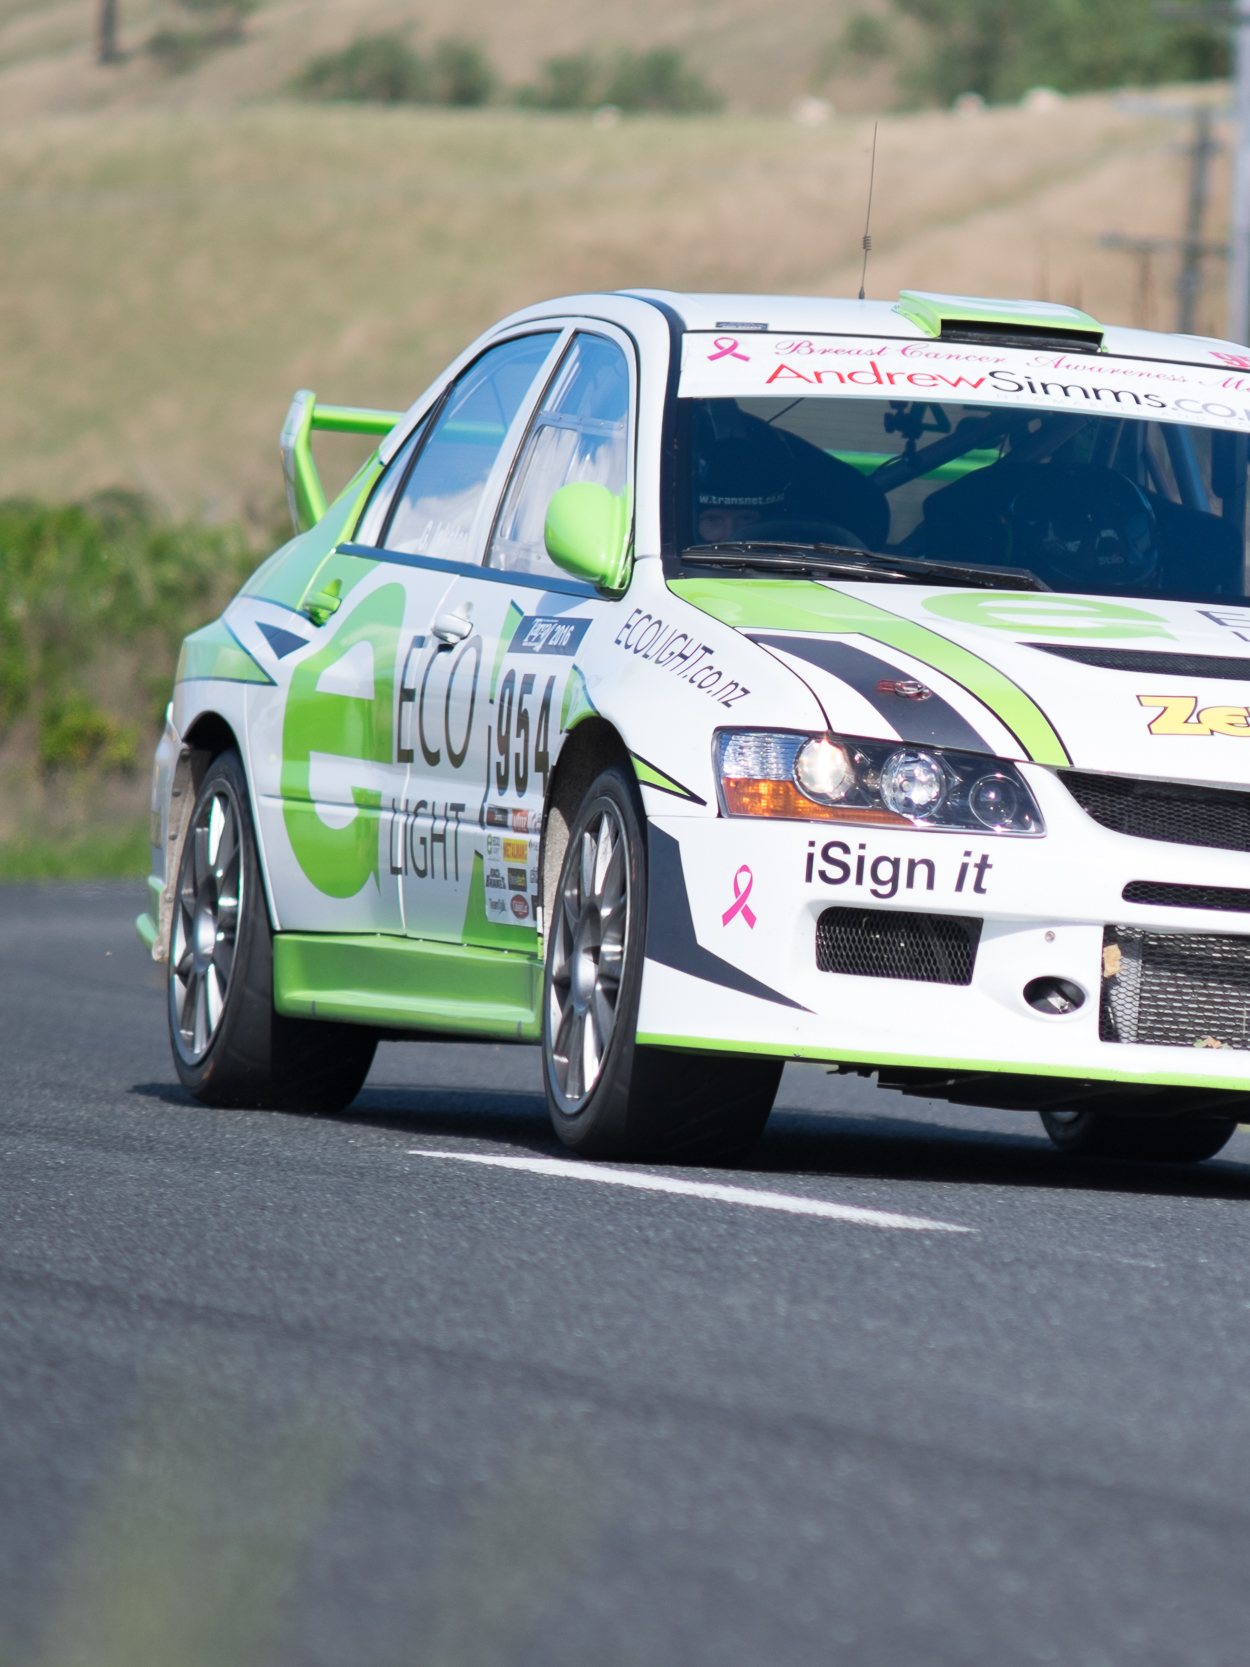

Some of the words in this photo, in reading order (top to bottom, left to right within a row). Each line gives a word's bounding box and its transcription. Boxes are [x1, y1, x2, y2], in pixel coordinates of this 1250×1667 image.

[775, 338, 887, 358] Breast
[900, 343, 1007, 365] Cancer
[1026, 354, 1188, 384] Awareness
[996, 393, 1145, 413] NEWMARKET
[1161, 410, 1207, 422] AND
[548, 624, 575, 646] 2016
[613, 607, 752, 709] ECOLIGHT.co.nz
[396, 634, 484, 769] ECO
[496, 668, 557, 799] 954
[389, 798, 466, 882] LIGHT
[804, 840, 936, 899] iSign
[954, 850, 993, 894] it
